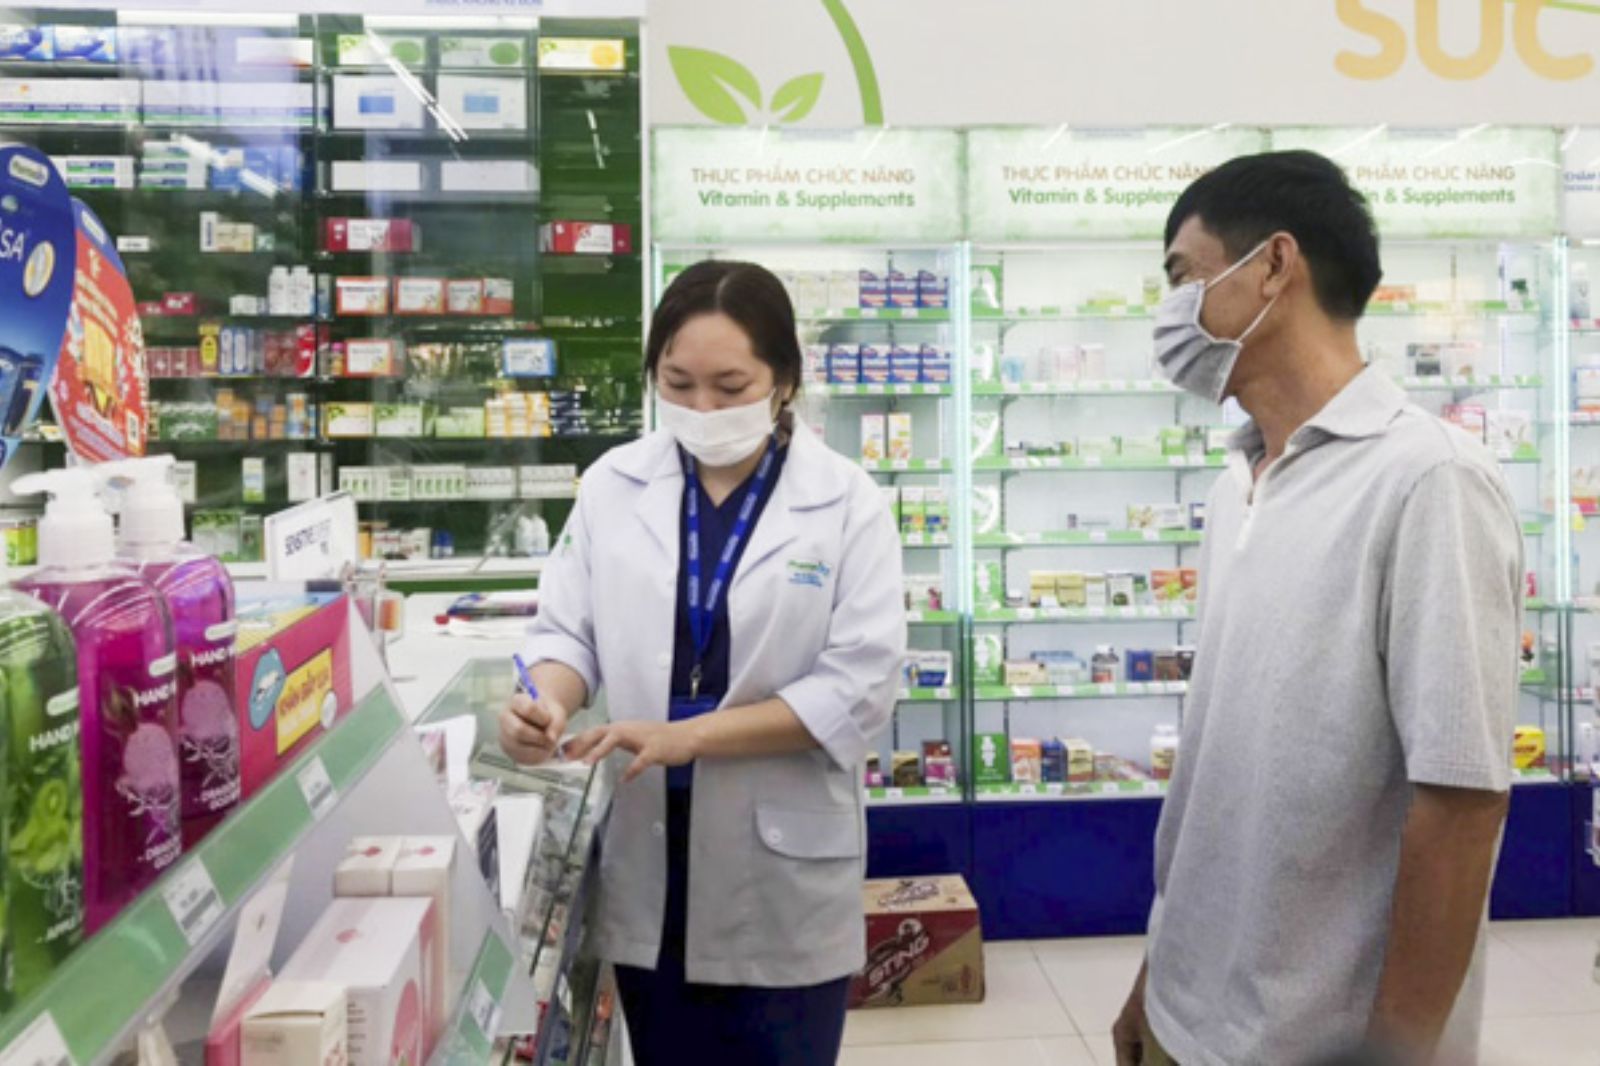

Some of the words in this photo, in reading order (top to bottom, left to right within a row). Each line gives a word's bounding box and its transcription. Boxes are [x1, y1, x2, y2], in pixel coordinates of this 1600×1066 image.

[692, 166, 741, 188] THỰC
[862, 164, 915, 184] NĂNG
[698, 190, 770, 207] Vitamin
[775, 190, 790, 207] &
[795, 189, 915, 211] Supplements
[1008, 187, 1079, 204] Vitamin
[1084, 187, 1098, 204] &
[1103, 186, 1180, 208] Supplem
[1383, 186, 1397, 204] &
[1402, 186, 1516, 208] Supplements
